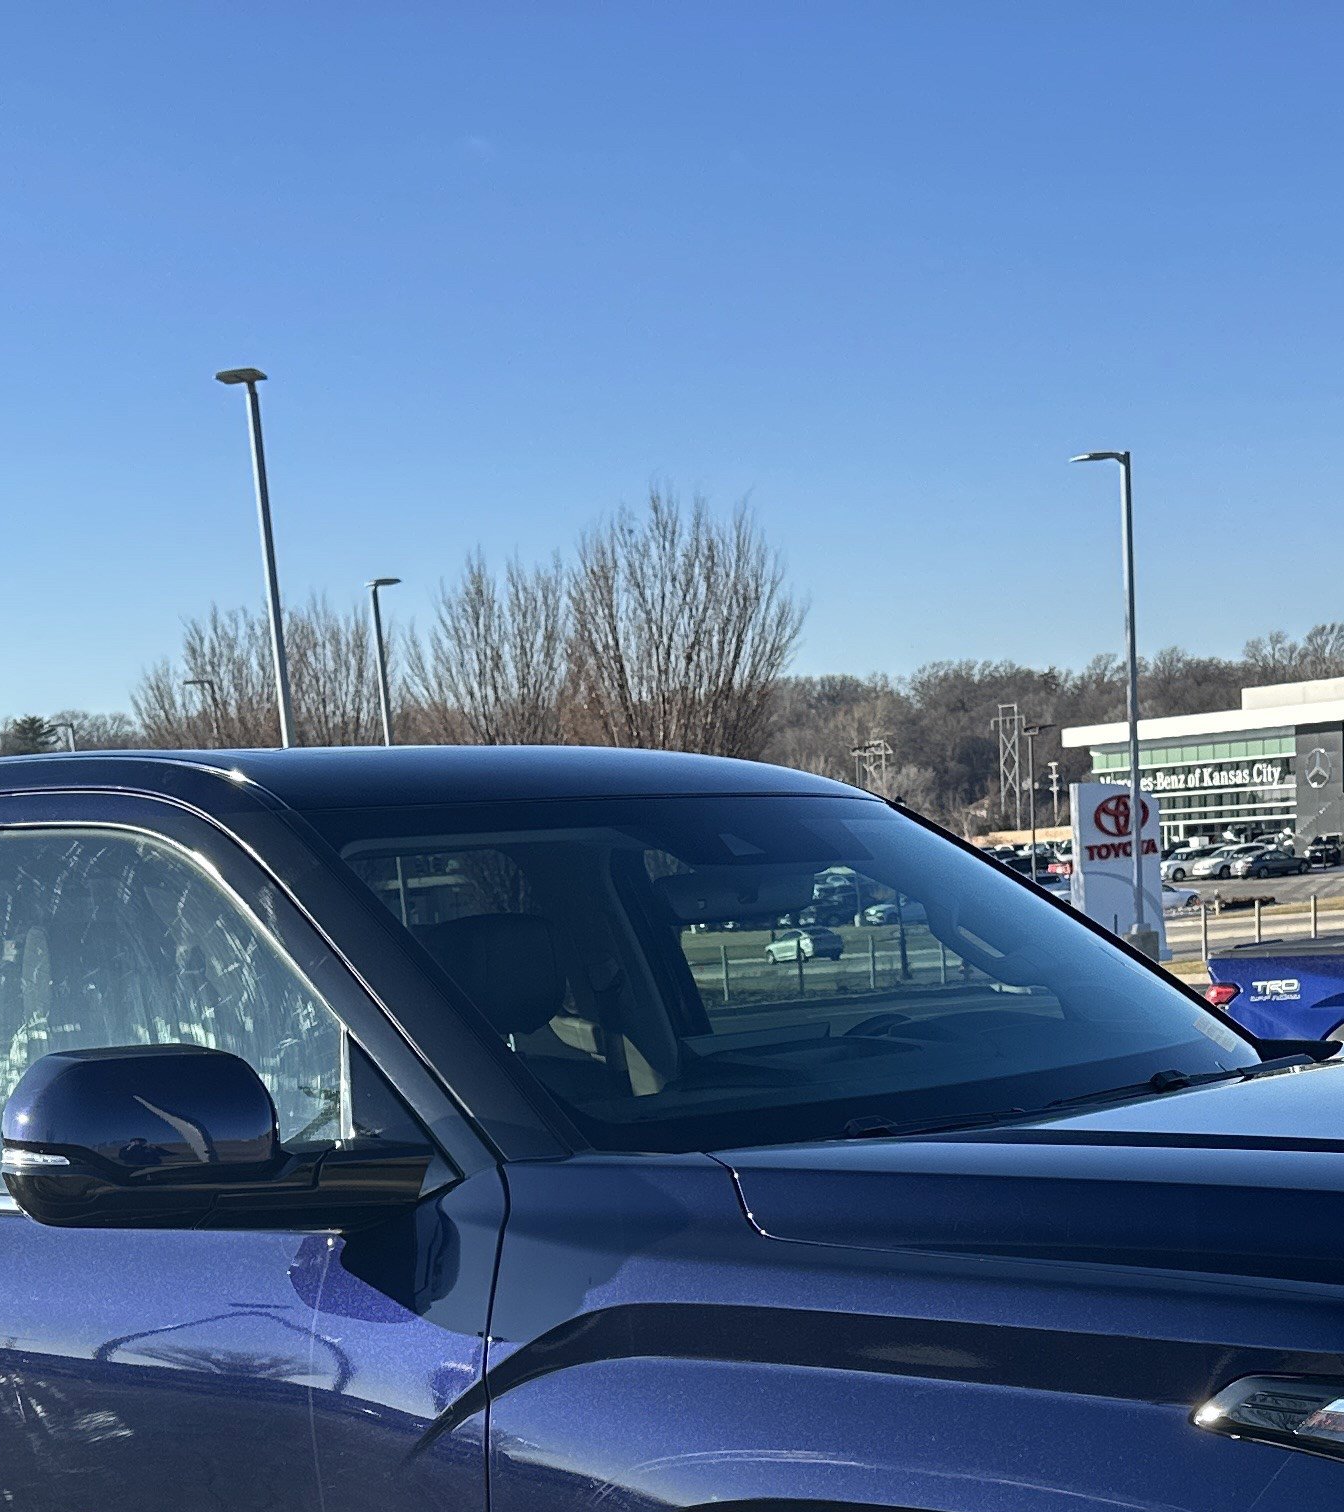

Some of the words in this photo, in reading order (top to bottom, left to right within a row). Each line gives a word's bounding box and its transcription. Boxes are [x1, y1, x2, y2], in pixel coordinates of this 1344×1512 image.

[1187, 768, 1201, 788] of
[1202, 767, 1251, 787] Kansas
[1252, 763, 1282, 787] City
[1251, 979, 1300, 995] TRD
